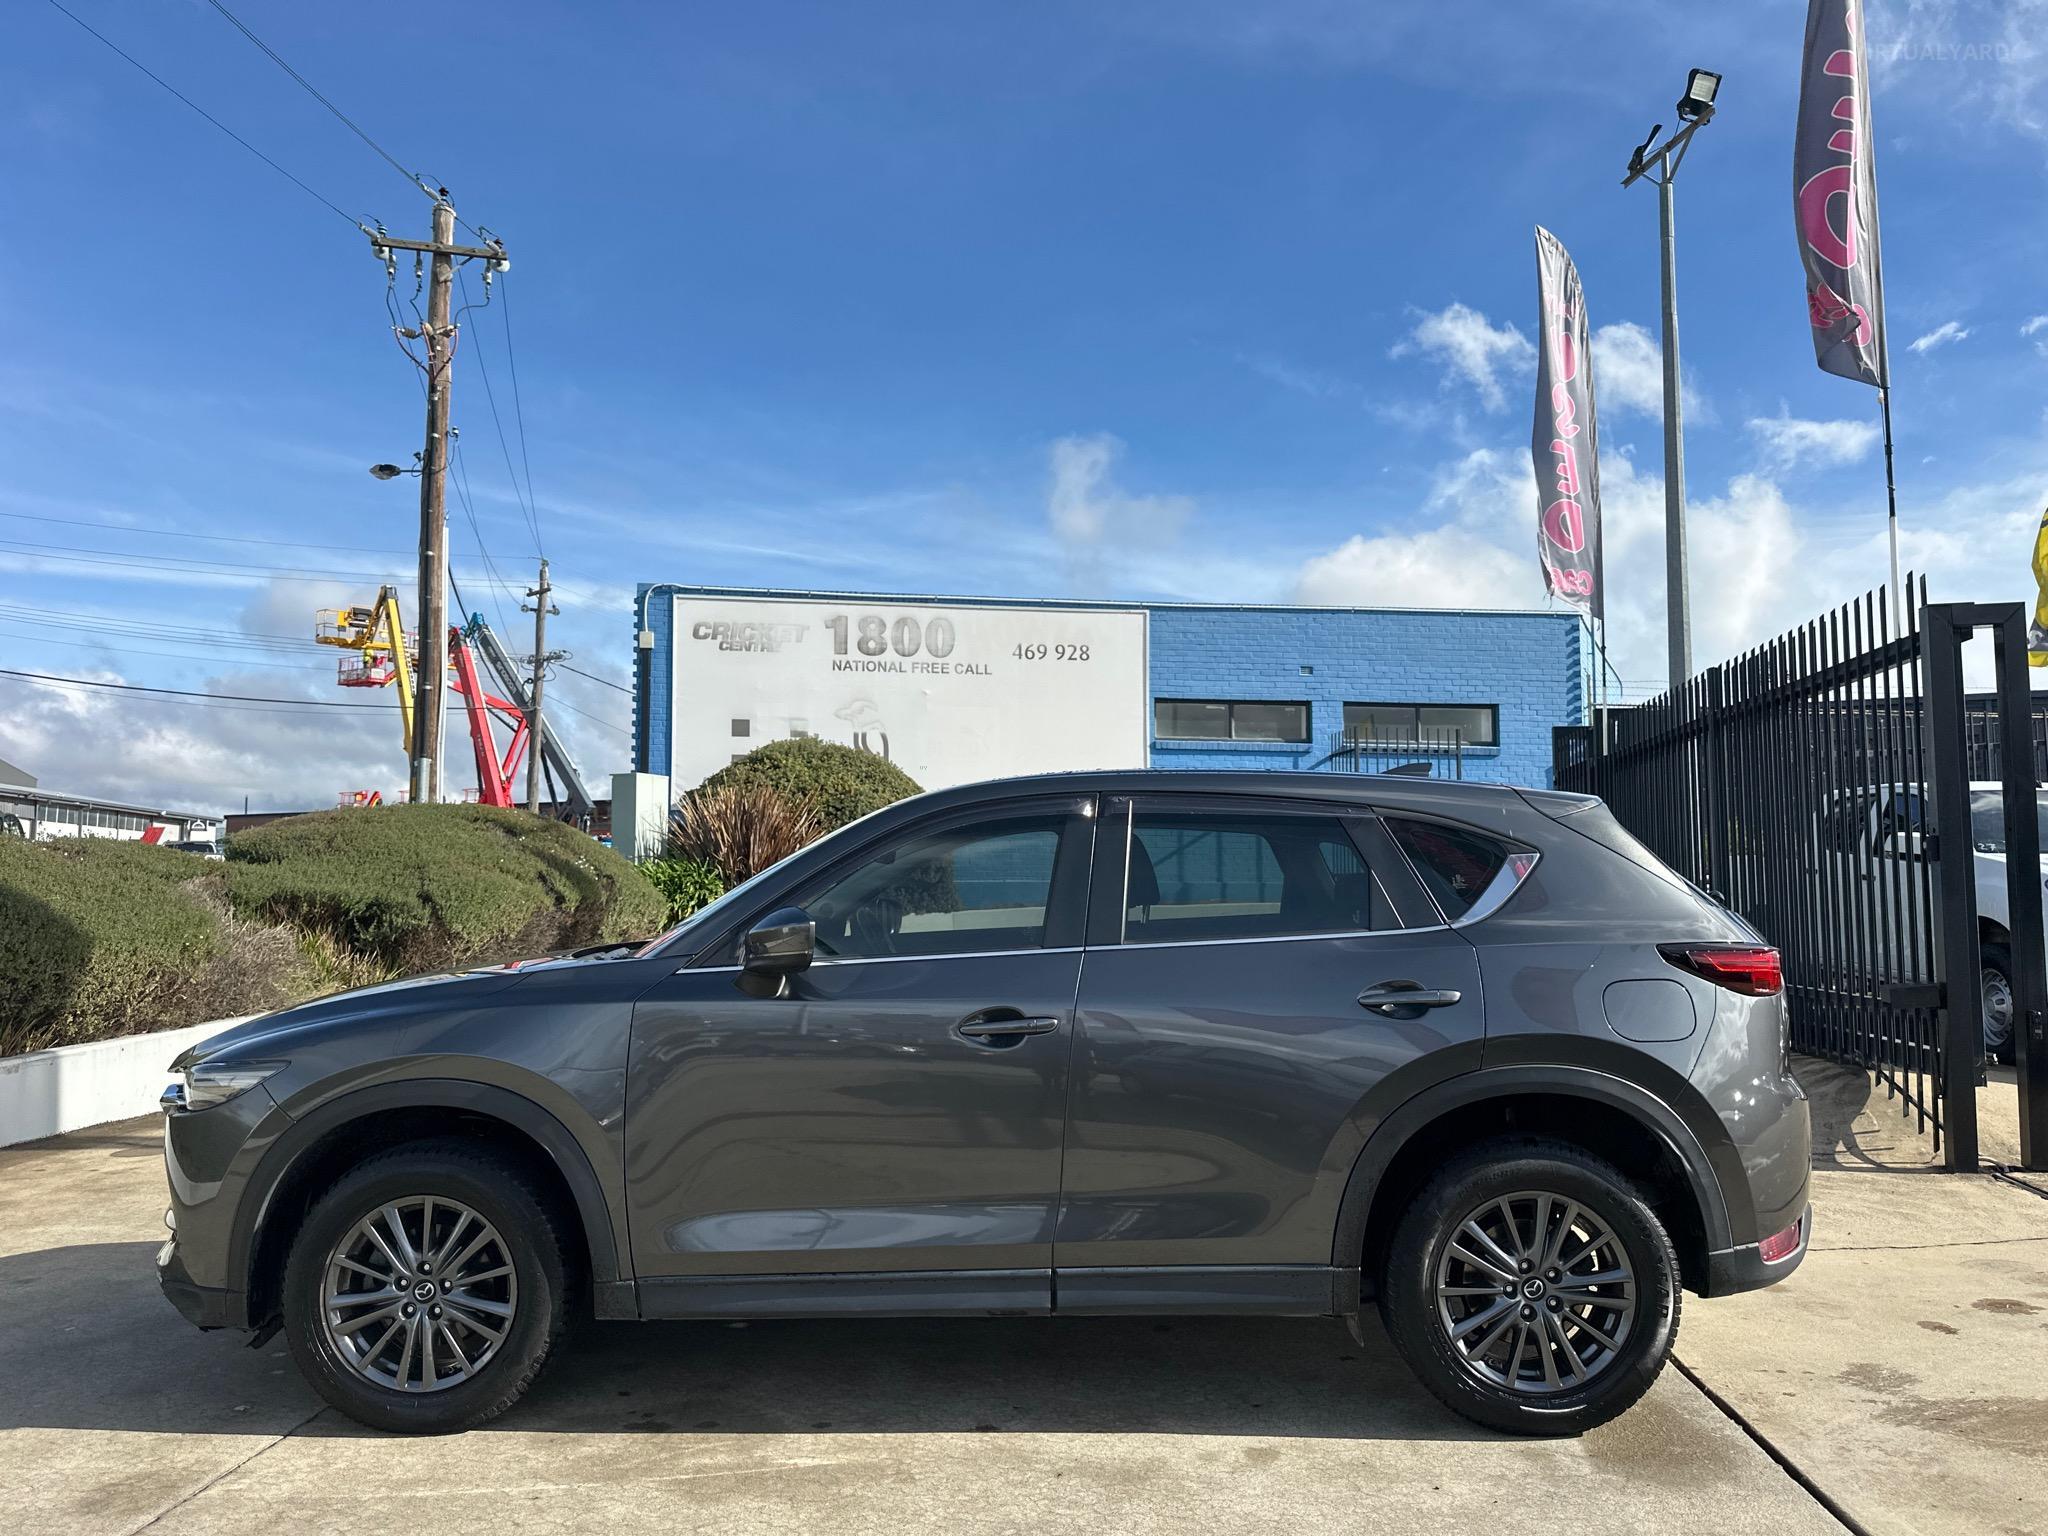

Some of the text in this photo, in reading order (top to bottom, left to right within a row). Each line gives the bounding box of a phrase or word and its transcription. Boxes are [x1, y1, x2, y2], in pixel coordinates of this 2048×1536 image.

[692, 621, 810, 643] CRICKET
[824, 615, 1090, 661] 1800 469 928
[832, 660, 993, 676] NATIONAL FREE CALL
